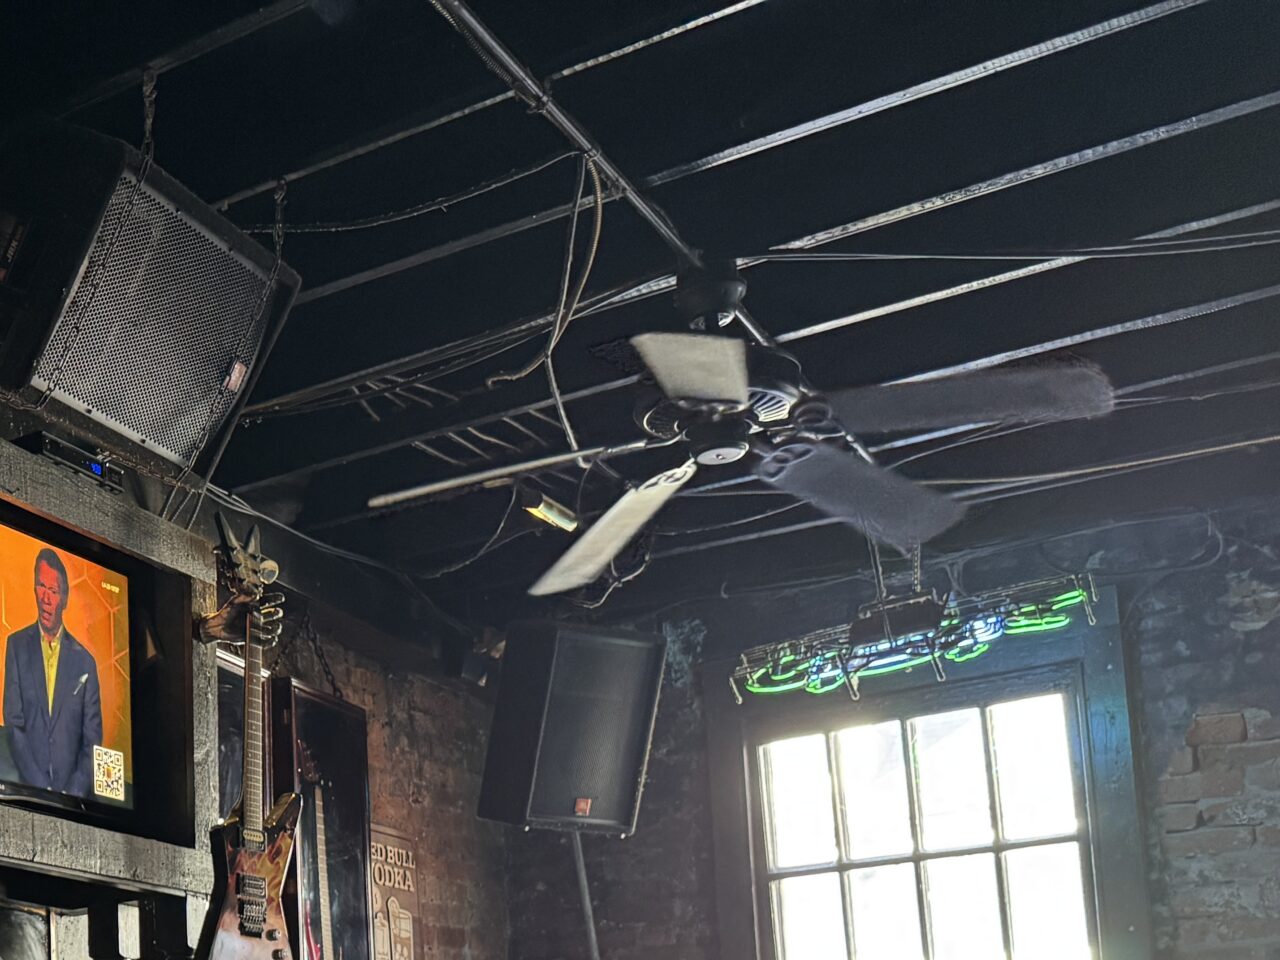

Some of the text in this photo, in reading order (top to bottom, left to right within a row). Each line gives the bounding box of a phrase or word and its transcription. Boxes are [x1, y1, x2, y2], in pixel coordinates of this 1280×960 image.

[371, 842, 416, 869] ED BULL
[371, 861, 415, 892] ODKA
